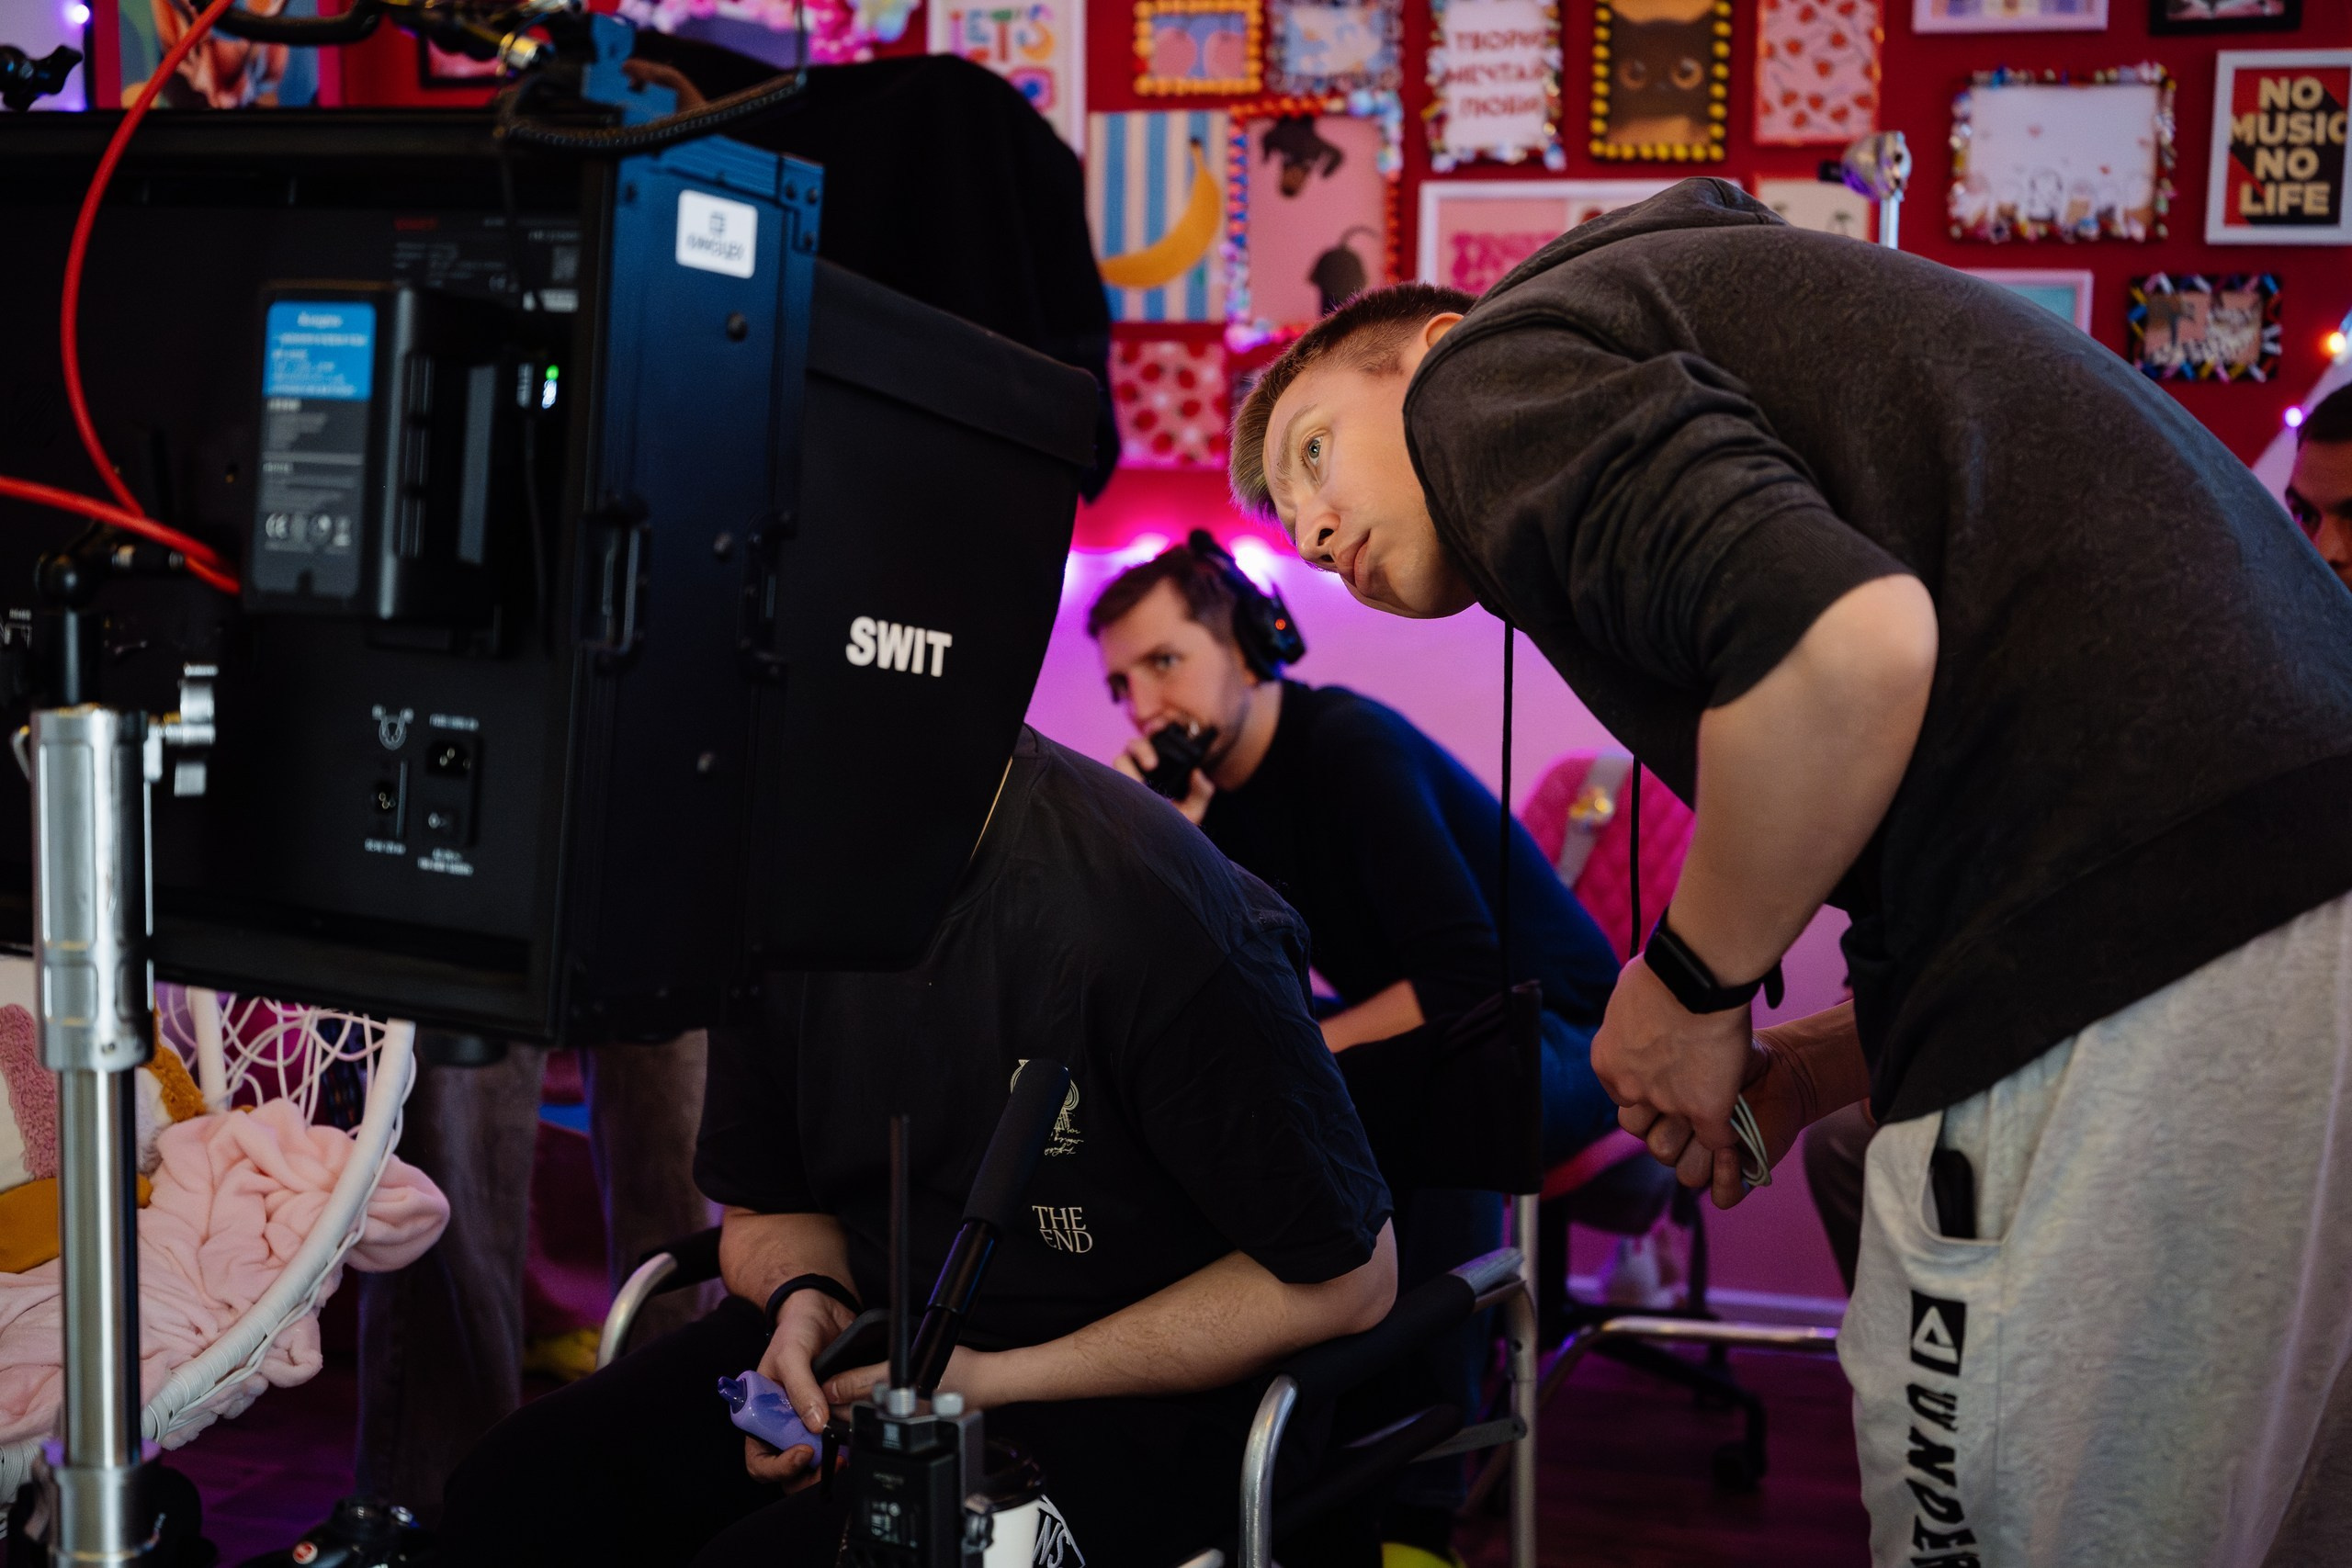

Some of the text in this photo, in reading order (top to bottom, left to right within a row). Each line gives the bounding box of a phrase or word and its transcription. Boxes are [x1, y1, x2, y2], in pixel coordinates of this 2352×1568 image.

[2258, 75, 2324, 111] NO
[2231, 109, 2347, 147] MUSIC
[2254, 146, 2320, 182] NO
[2239, 181, 2332, 217] LIFE
[845, 615, 953, 678] SWIT
[1031, 1205, 1087, 1231] THE
[1038, 1229, 1093, 1254] END
